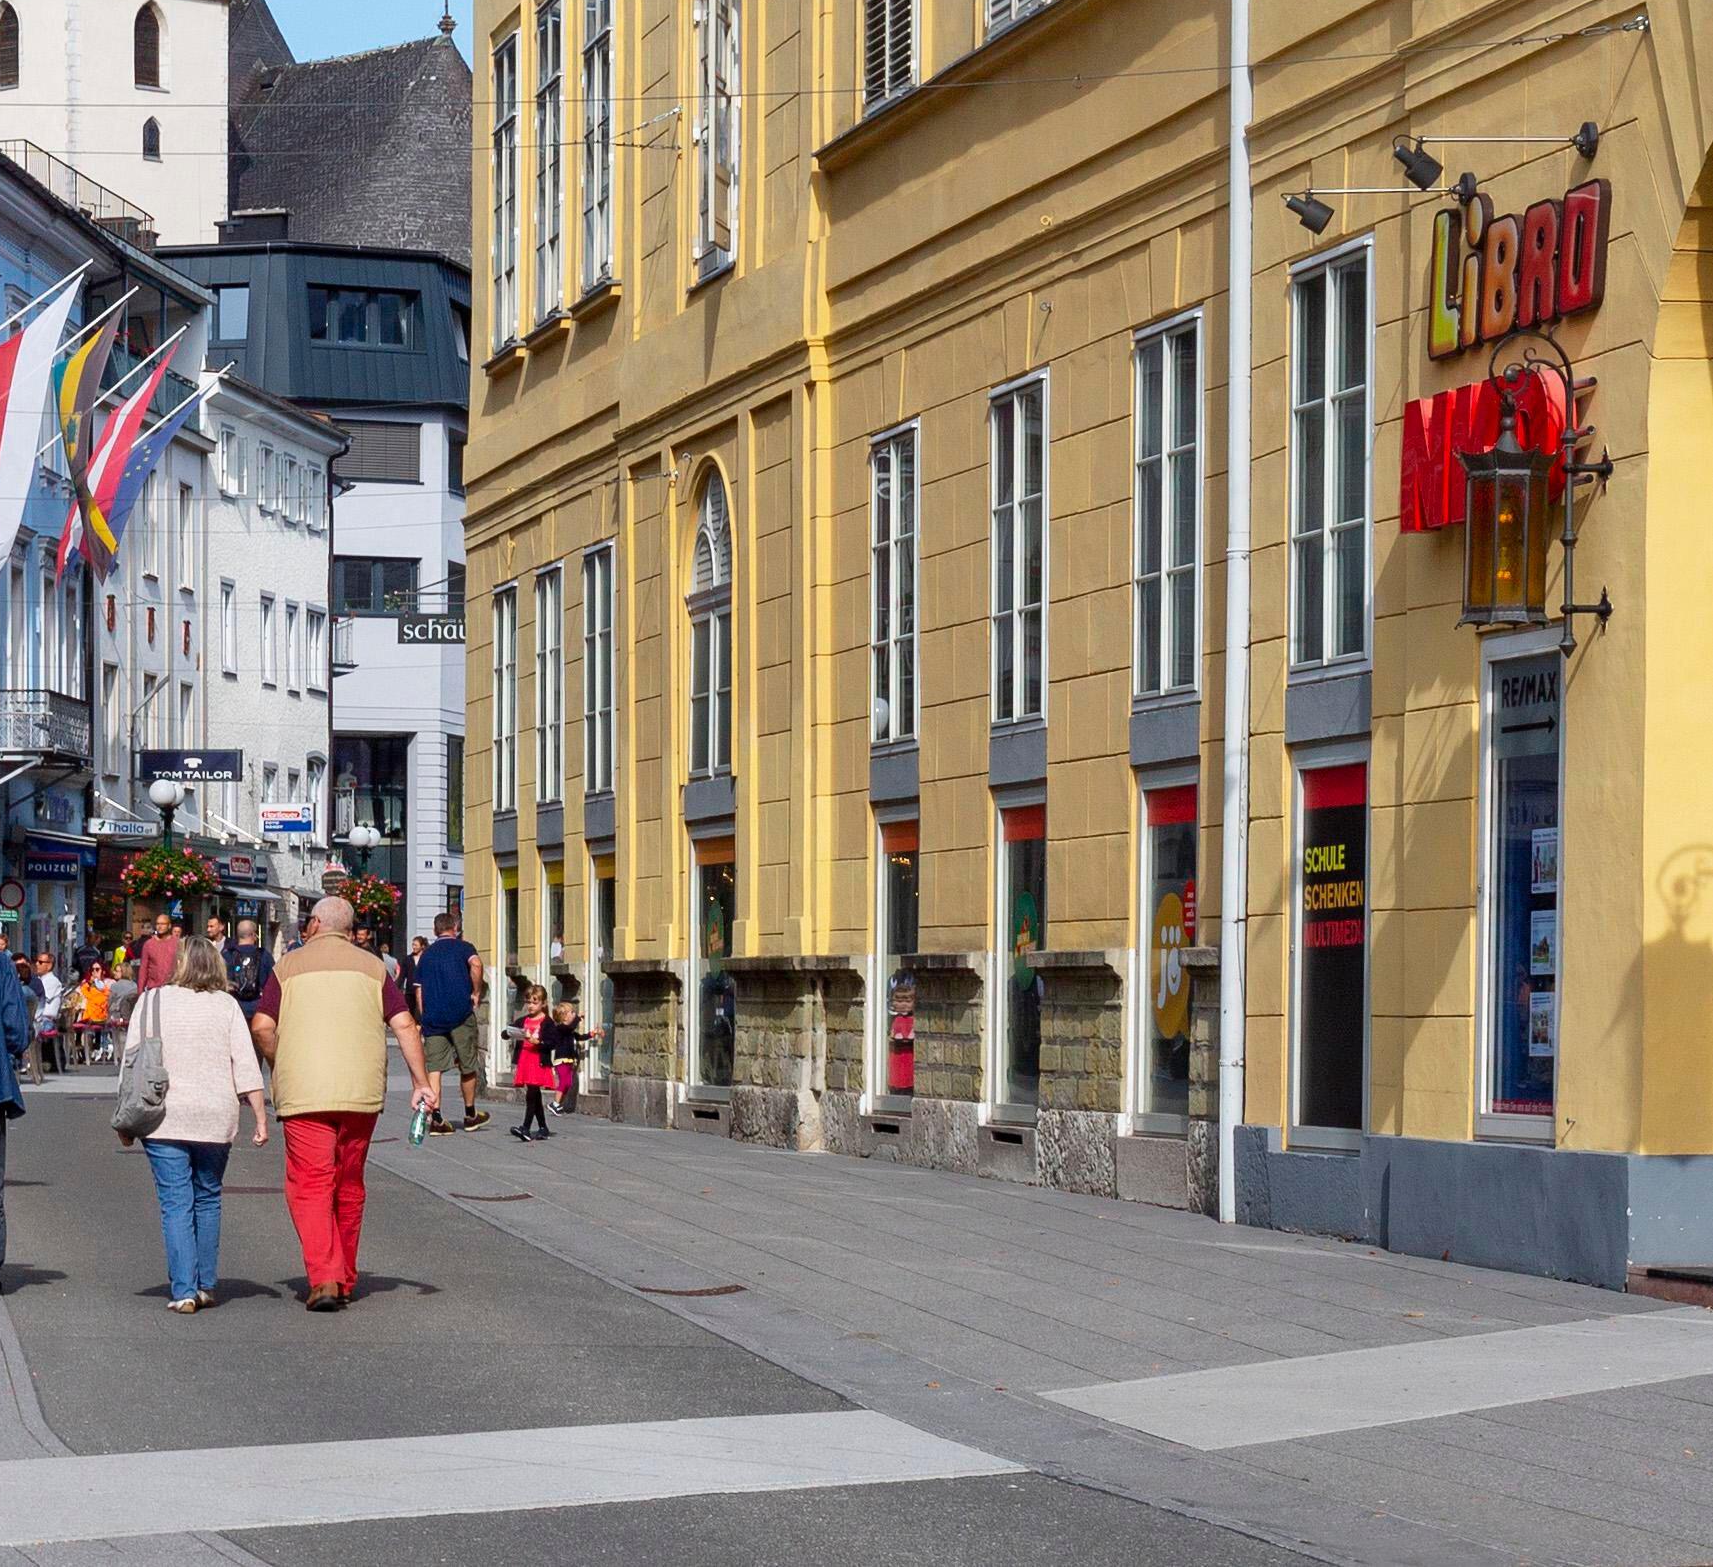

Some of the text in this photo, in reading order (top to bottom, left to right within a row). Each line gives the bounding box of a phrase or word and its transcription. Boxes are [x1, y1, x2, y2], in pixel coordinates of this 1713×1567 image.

[1501, 671, 1557, 708] RE/MAX
[152, 770, 233, 780] TOM TAILOR
[28, 863, 70, 873] POLIZEI
[1304, 844, 1346, 874] SCHULE
[1304, 880, 1364, 911] SCHENKEN
